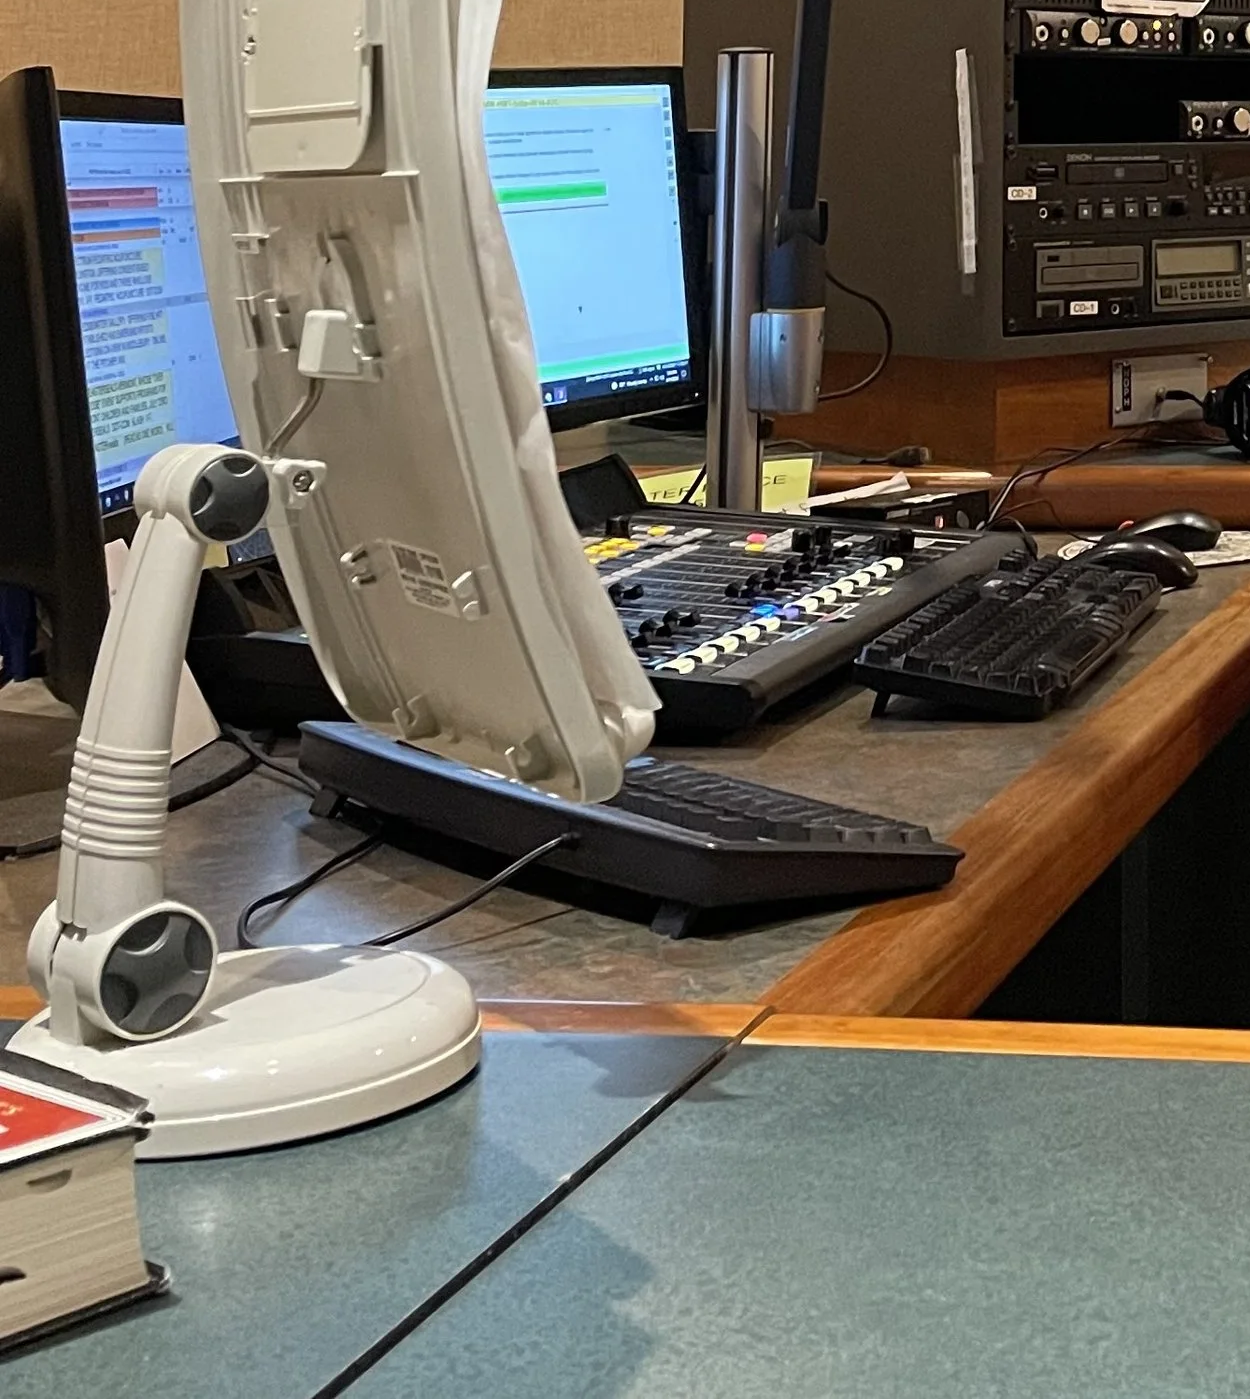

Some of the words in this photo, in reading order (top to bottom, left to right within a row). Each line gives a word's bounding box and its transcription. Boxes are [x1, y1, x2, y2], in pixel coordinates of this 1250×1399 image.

[1066, 153, 1093, 162] DENON
[1011, 188, 1034, 199] CD-2
[1074, 303, 1095, 313] CD-1
